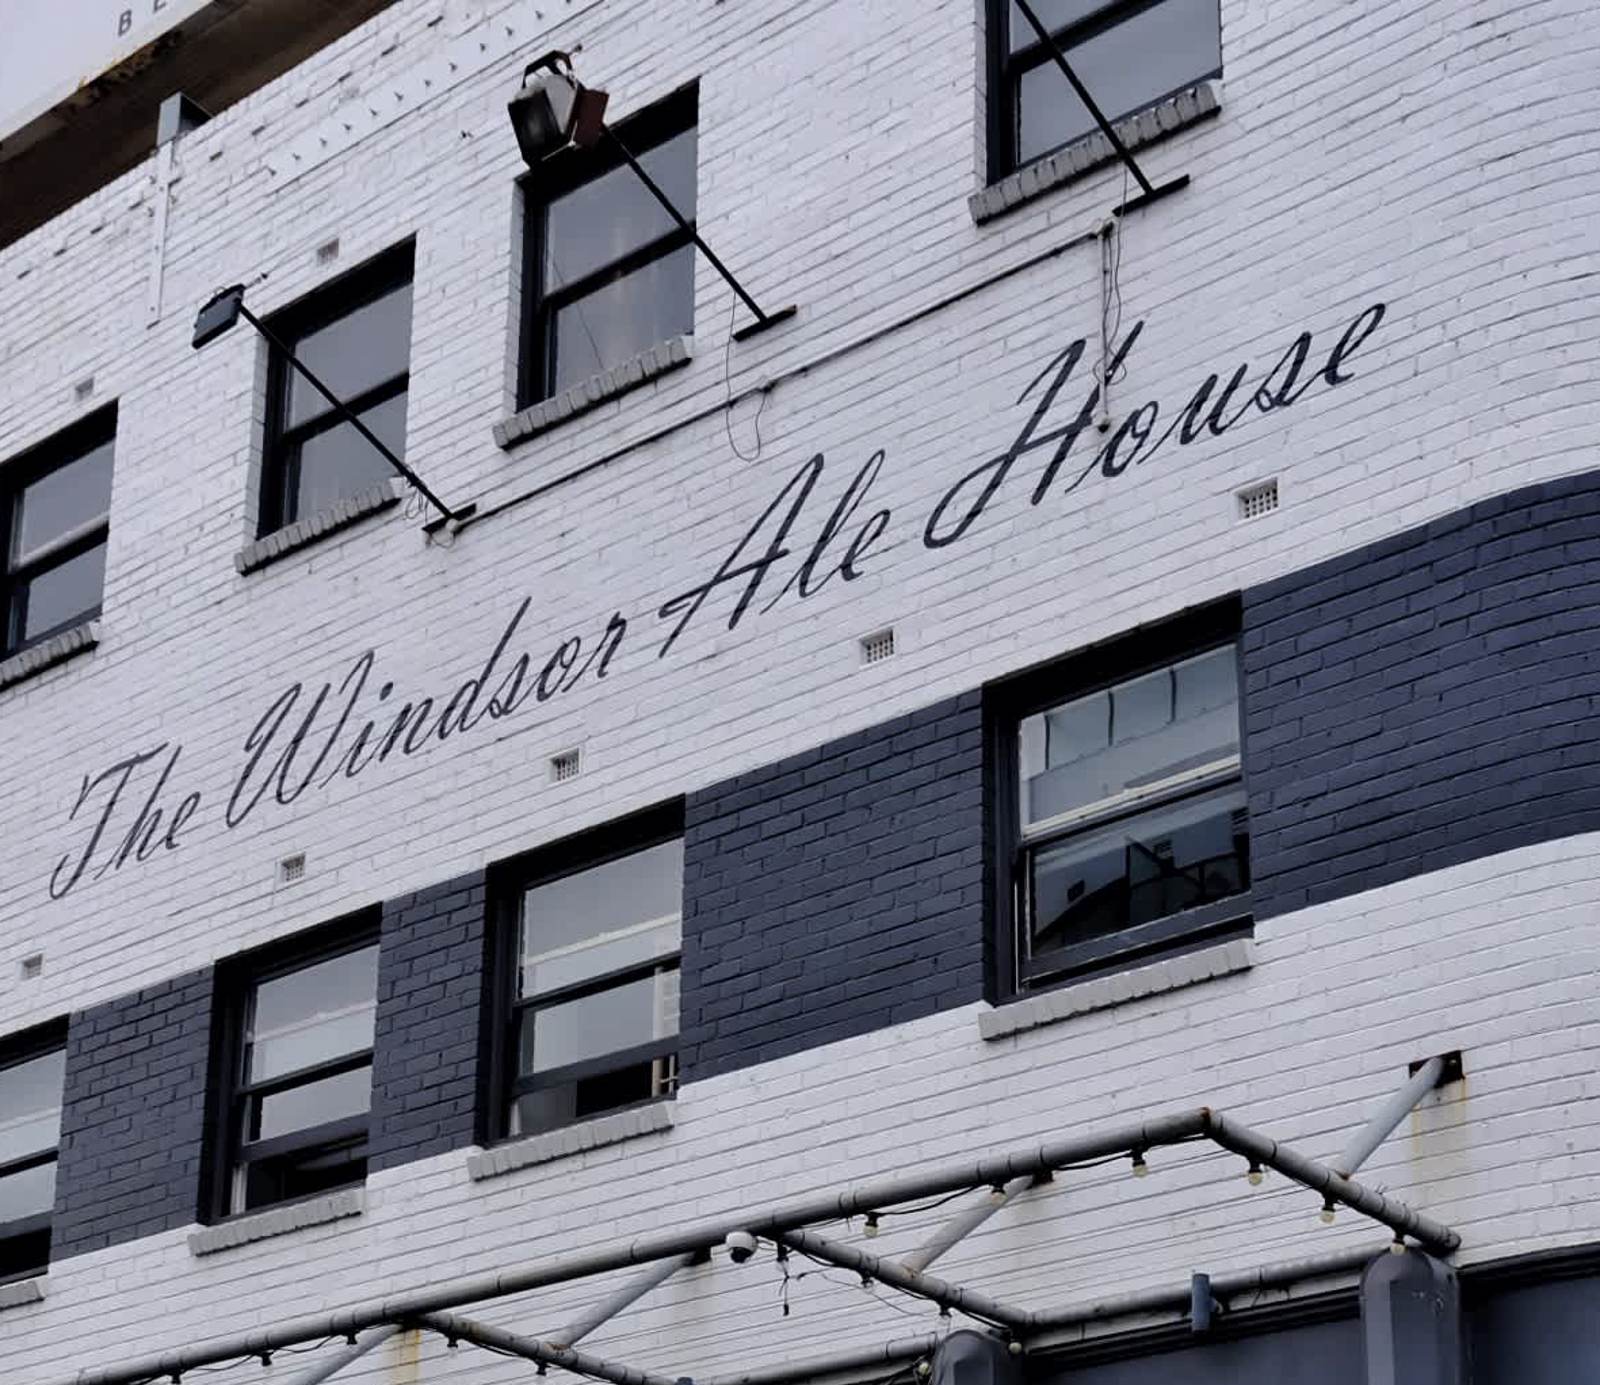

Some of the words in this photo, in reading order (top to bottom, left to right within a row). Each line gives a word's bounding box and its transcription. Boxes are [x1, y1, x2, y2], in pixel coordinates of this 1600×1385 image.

[49, 744, 203, 900] The
[225, 597, 629, 828] Windsor
[658, 449, 892, 659] Ale
[923, 302, 1387, 549] House
